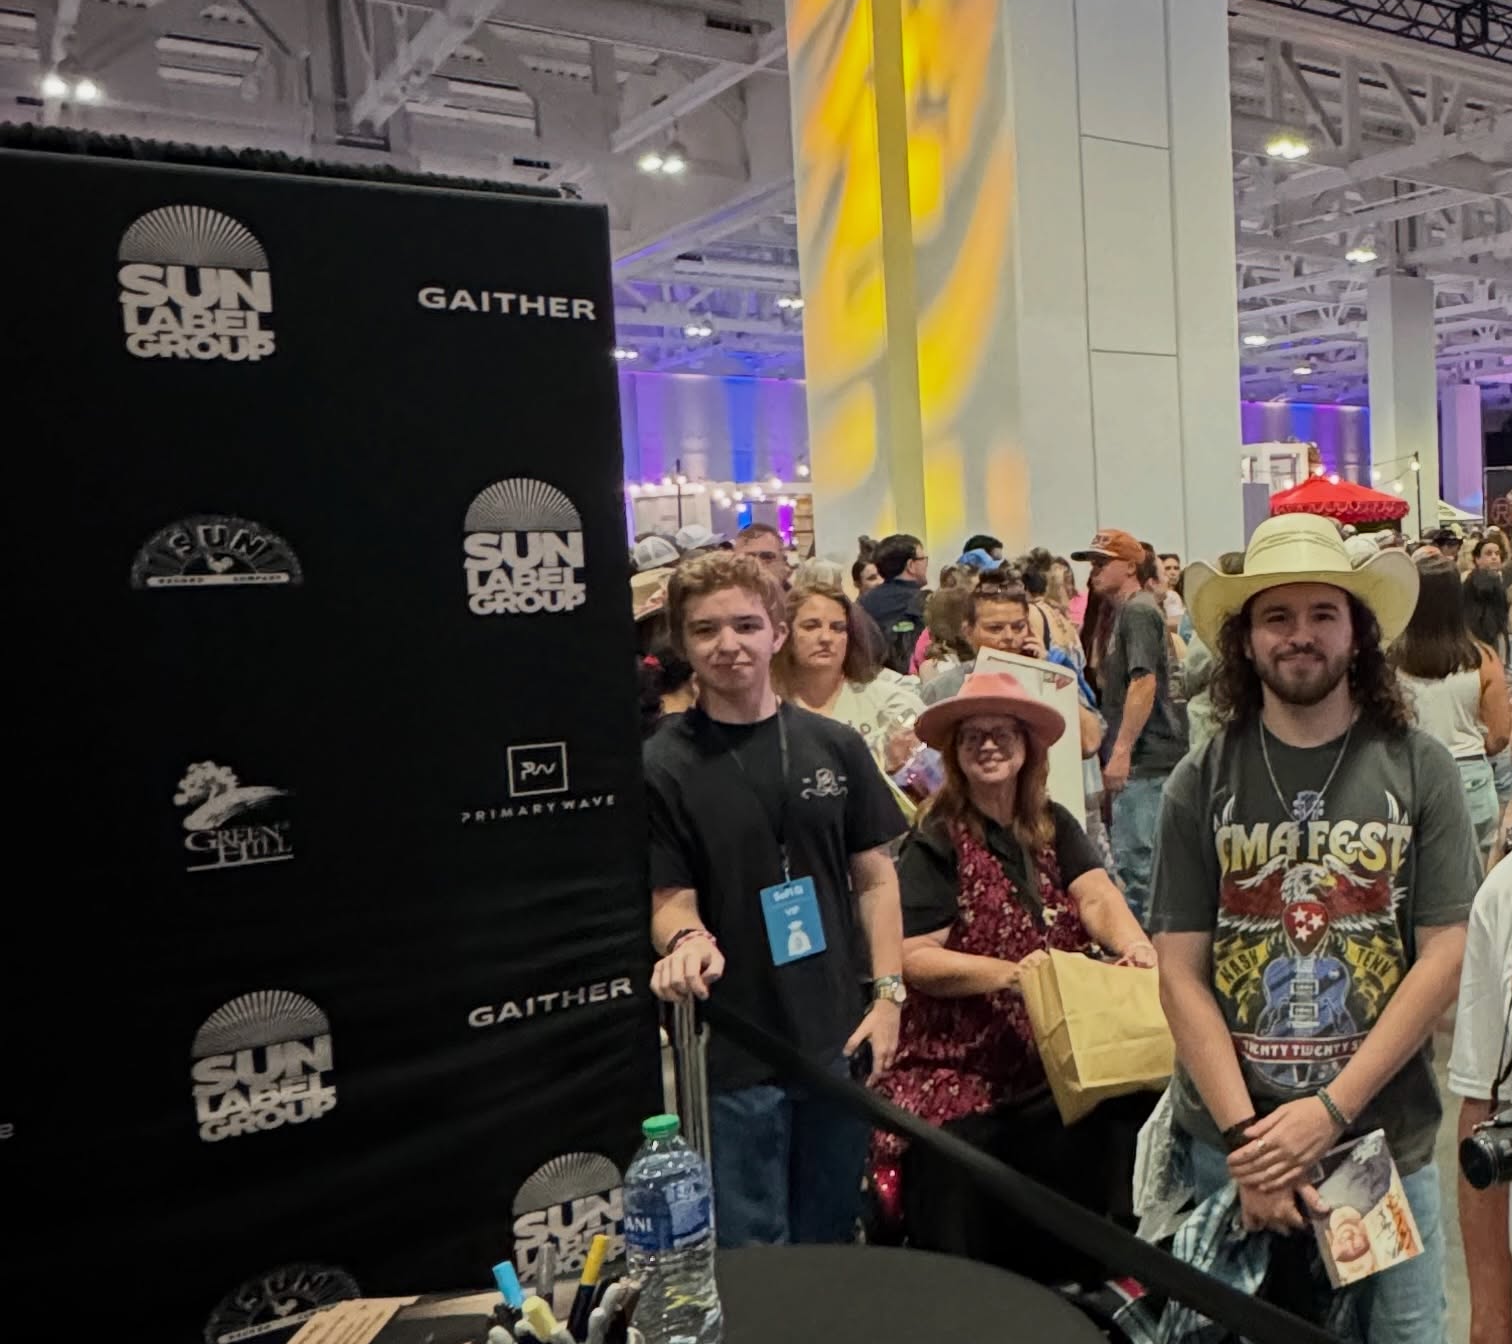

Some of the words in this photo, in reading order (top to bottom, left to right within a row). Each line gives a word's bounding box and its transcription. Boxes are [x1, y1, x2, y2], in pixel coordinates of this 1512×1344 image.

[118, 263, 273, 313] SUN
[417, 287, 597, 321] GAITHER
[123, 304, 275, 340] LABEL
[126, 333, 276, 361] GROUP
[168, 524, 267, 560] SUN
[463, 531, 585, 571] SUN
[467, 566, 586, 595] LABEL
[469, 590, 586, 615] GROUP
[1215, 820, 1300, 878] CMA
[1308, 819, 1413, 876] FEST
[1220, 947, 1259, 984] NASH
[1357, 947, 1393, 982] TENN
[467, 976, 634, 1028] GAITHER
[191, 1033, 334, 1096] SUN
[195, 1071, 337, 1124] LABEL
[199, 1093, 337, 1142] GROUP
[513, 1186, 625, 1250] SUN
